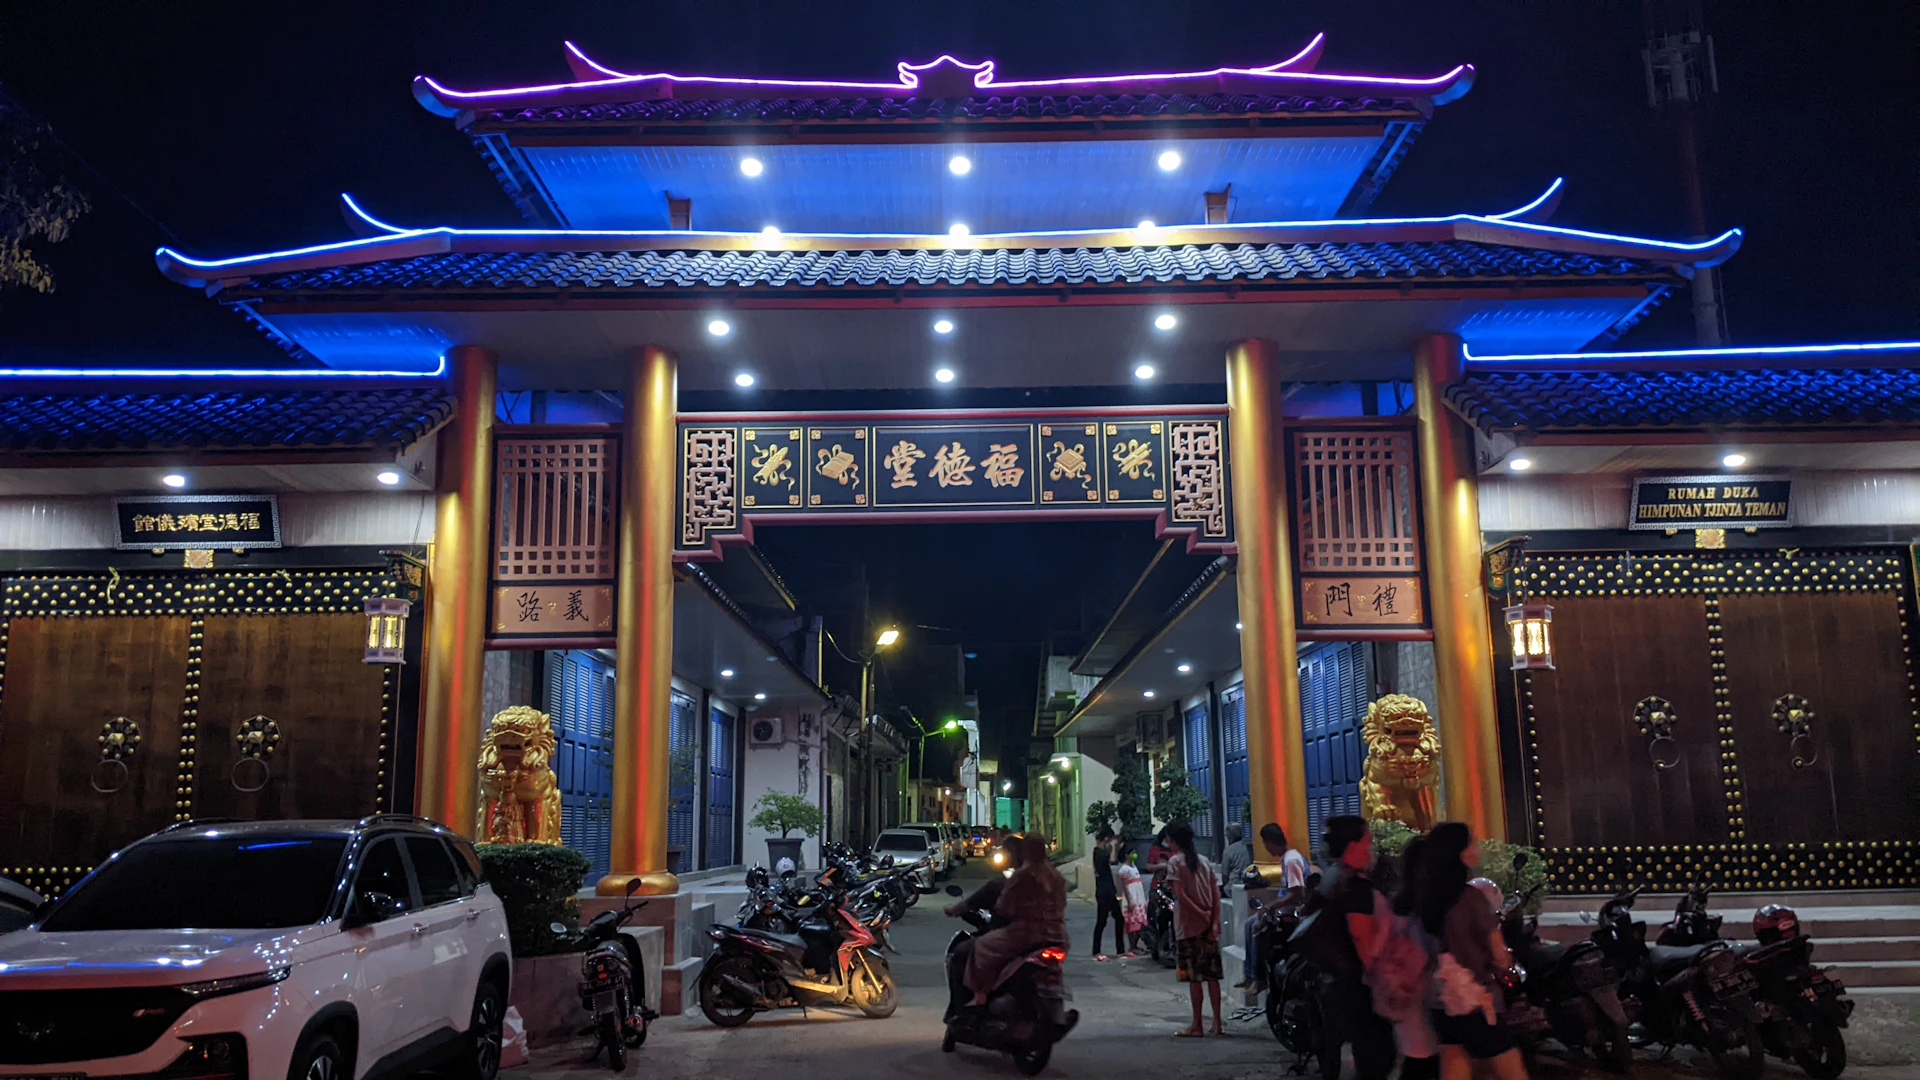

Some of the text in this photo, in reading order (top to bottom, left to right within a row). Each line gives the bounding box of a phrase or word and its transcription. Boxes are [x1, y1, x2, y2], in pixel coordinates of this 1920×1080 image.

[1668, 487, 1759, 500] RUMAH DUKA
[1638, 502, 1786, 518] HIMPUNAN TJINTA TEMAN
